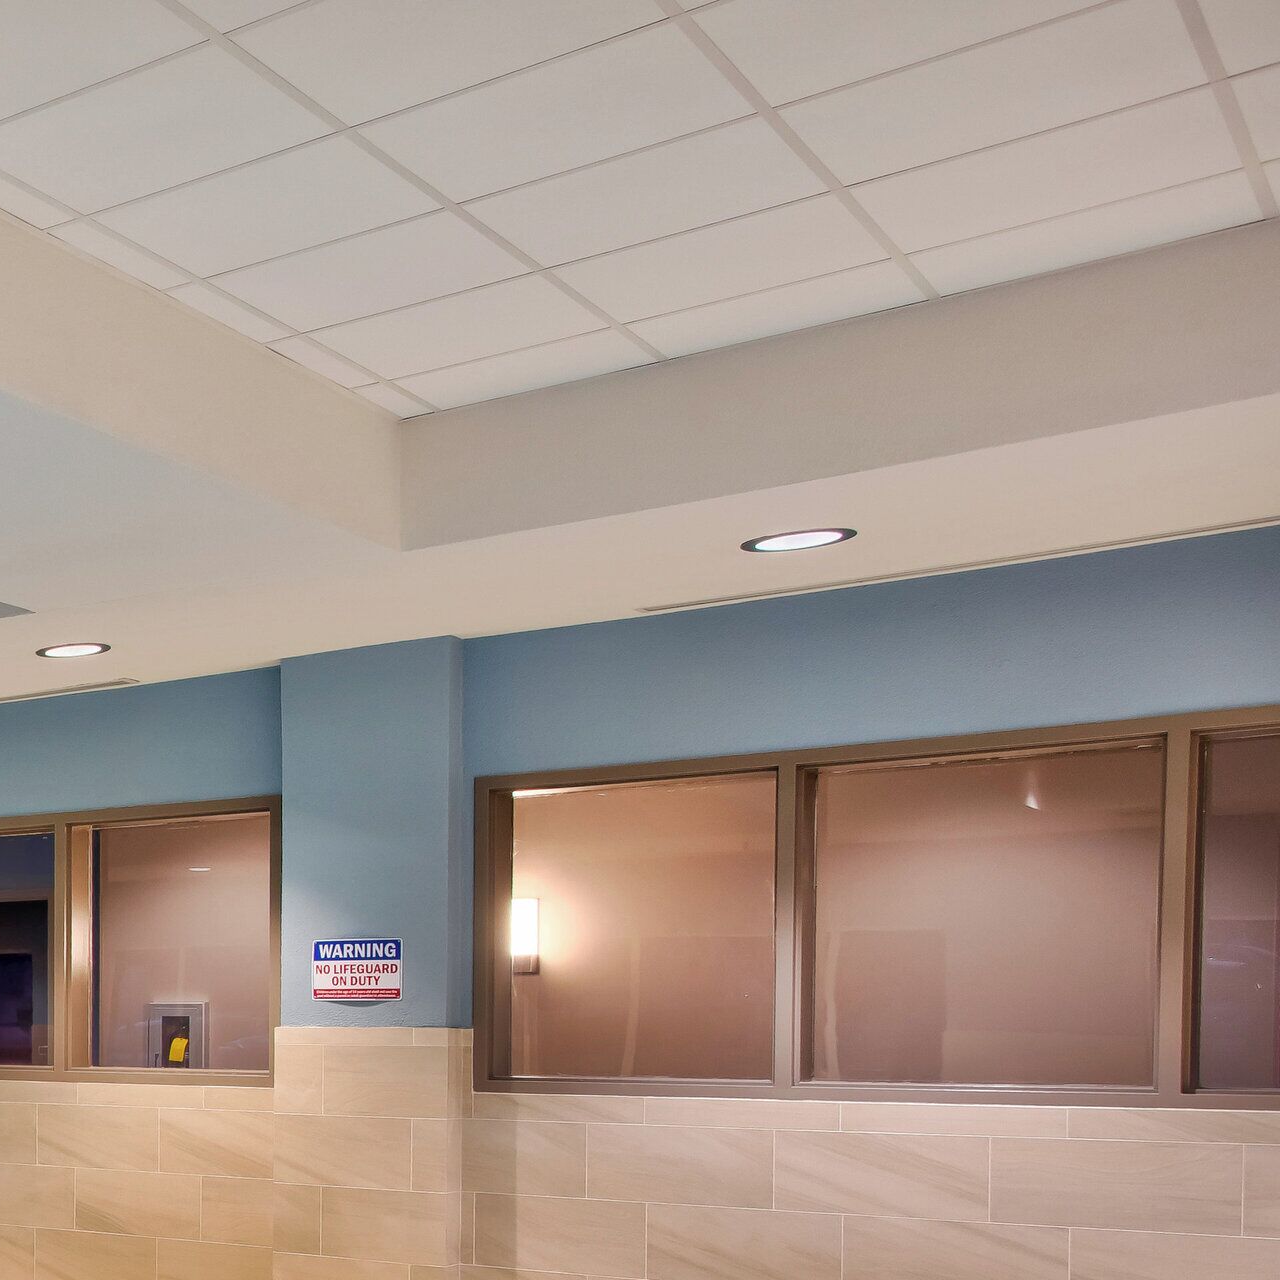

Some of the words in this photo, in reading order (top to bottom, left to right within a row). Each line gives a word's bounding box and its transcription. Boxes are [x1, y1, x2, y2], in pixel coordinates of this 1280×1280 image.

[318, 942, 397, 959] WARNING
[315, 964, 331, 975] NO
[333, 963, 399, 974] LIFEGUARD
[331, 975, 347, 986] ON
[350, 975, 381, 986] DUTY
